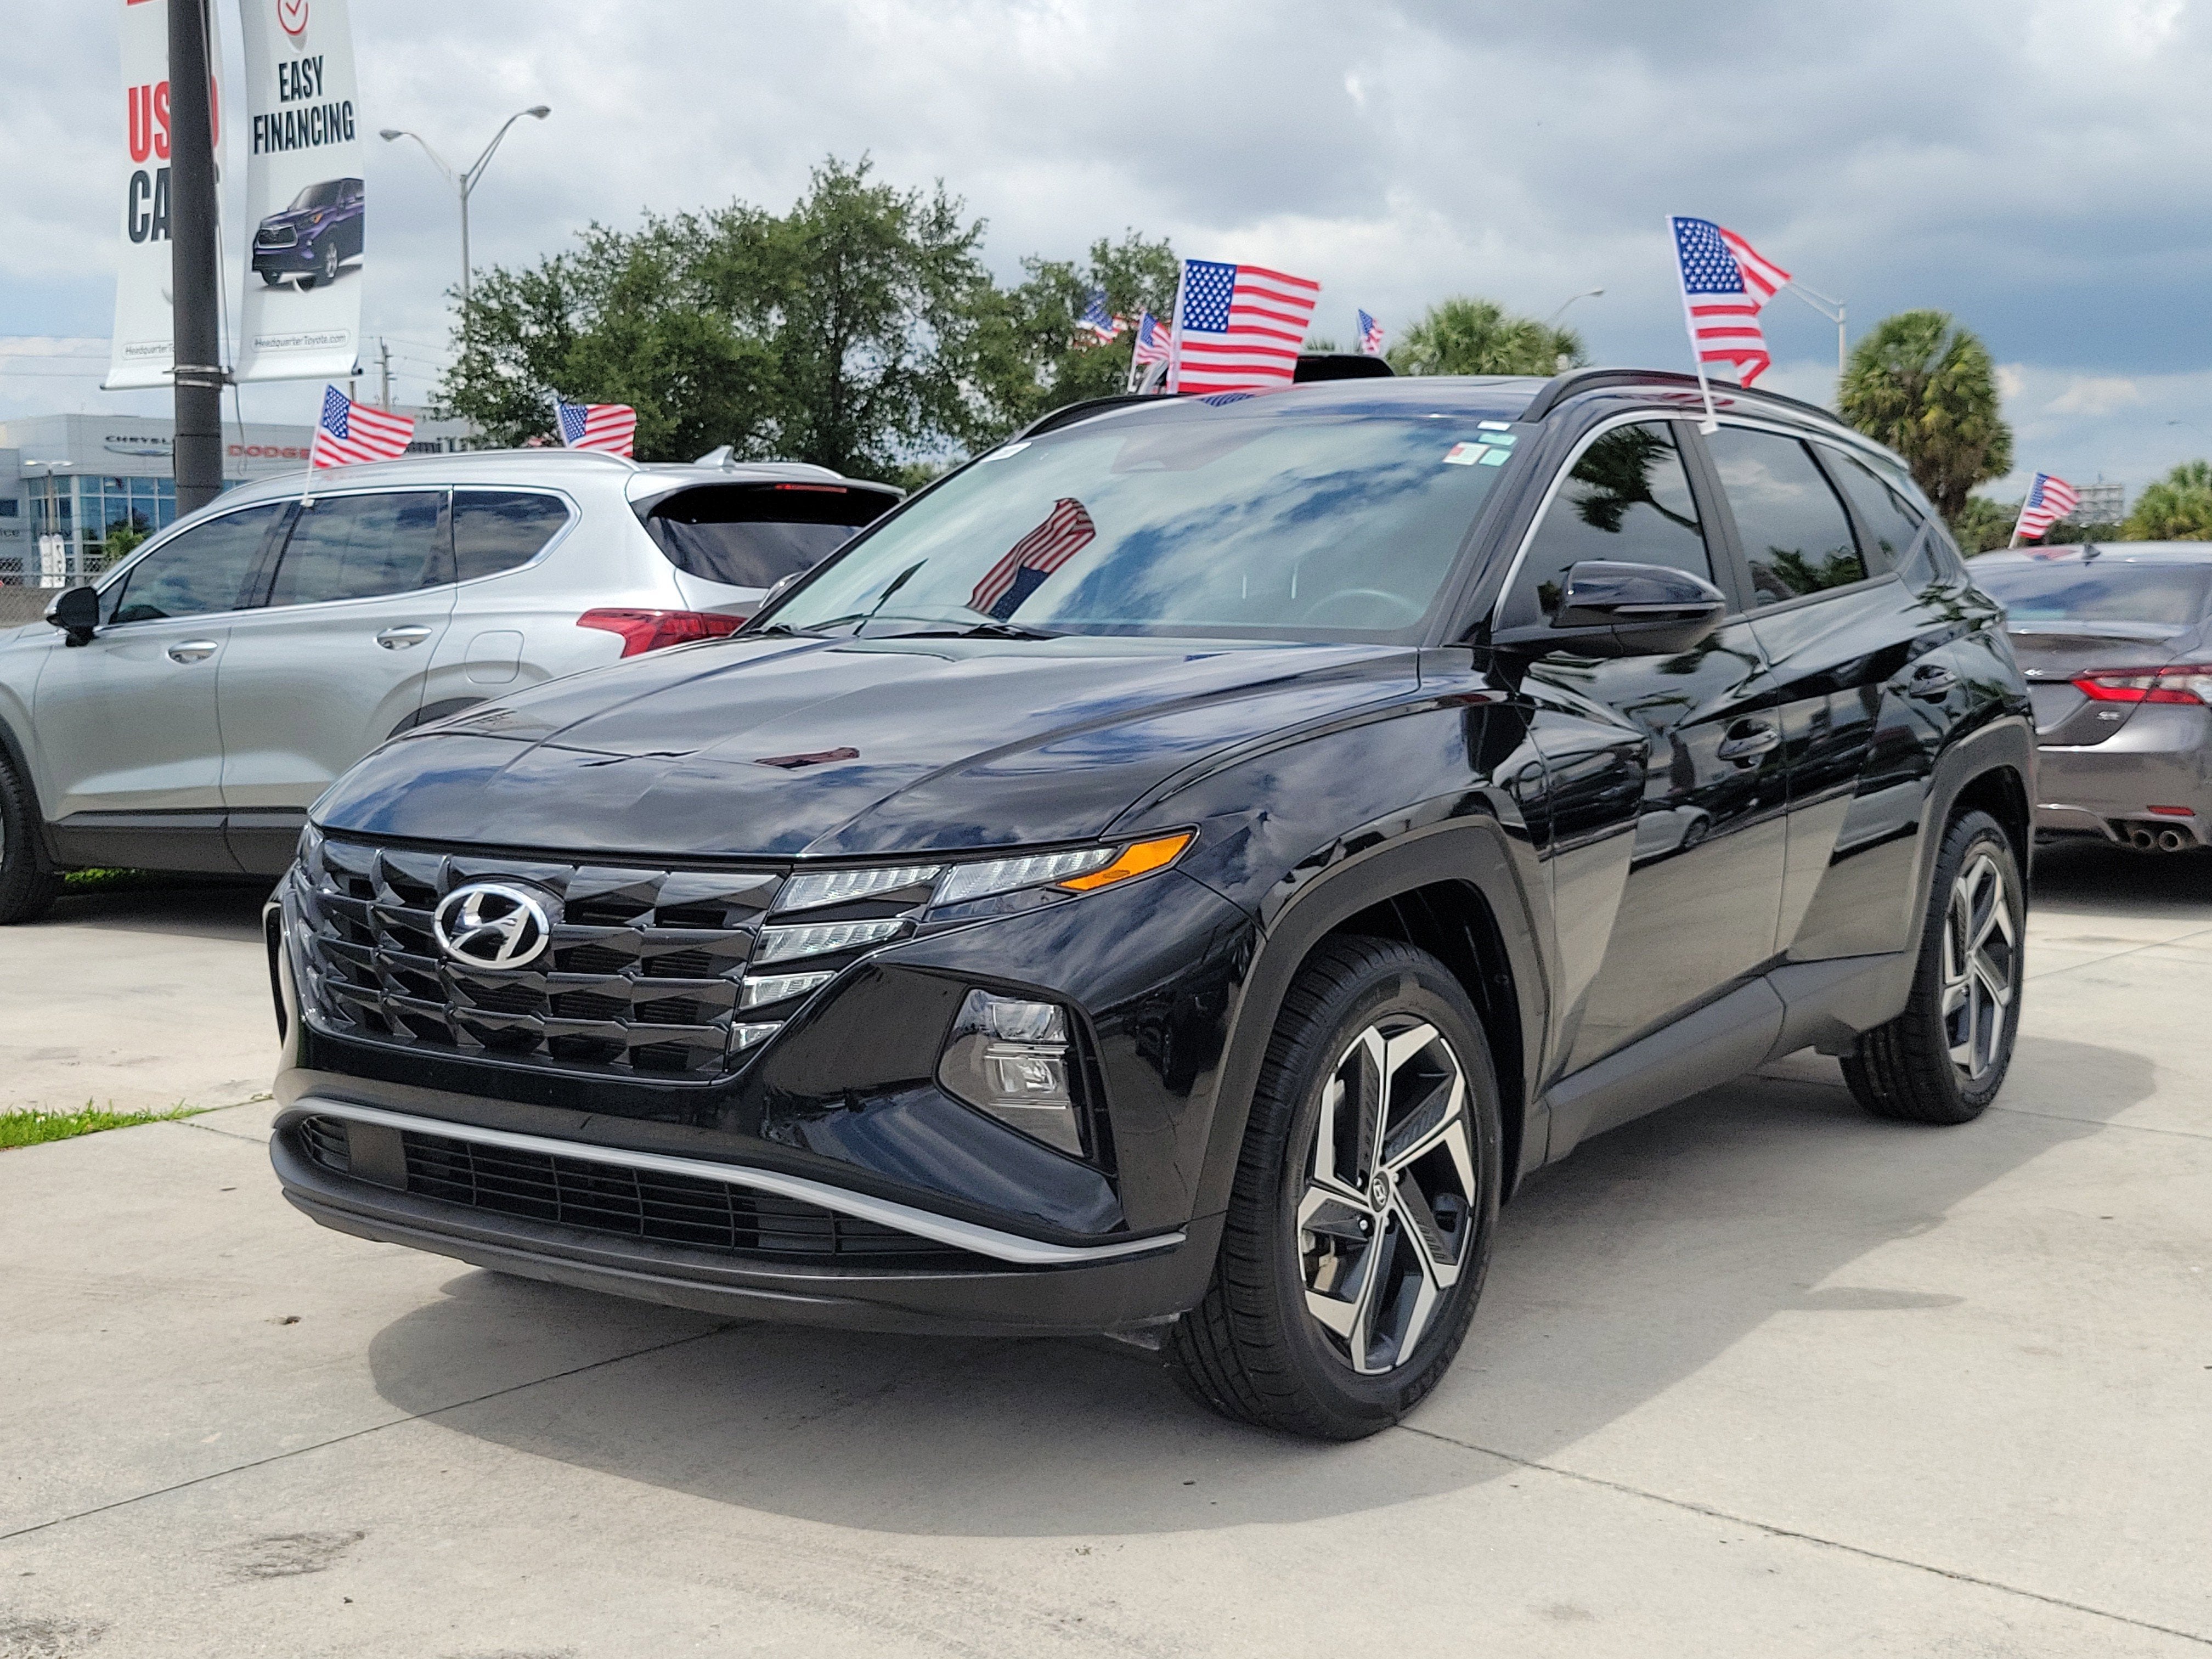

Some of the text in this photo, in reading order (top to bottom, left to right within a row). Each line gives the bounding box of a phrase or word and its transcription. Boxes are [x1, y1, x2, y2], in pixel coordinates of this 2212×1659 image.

[279, 54, 324, 103] EASY
[128, 75, 219, 163] US
[253, 100, 356, 155] FINANCING
[105, 436, 171, 445] CHRYSL
[229, 445, 312, 460] DODGE
